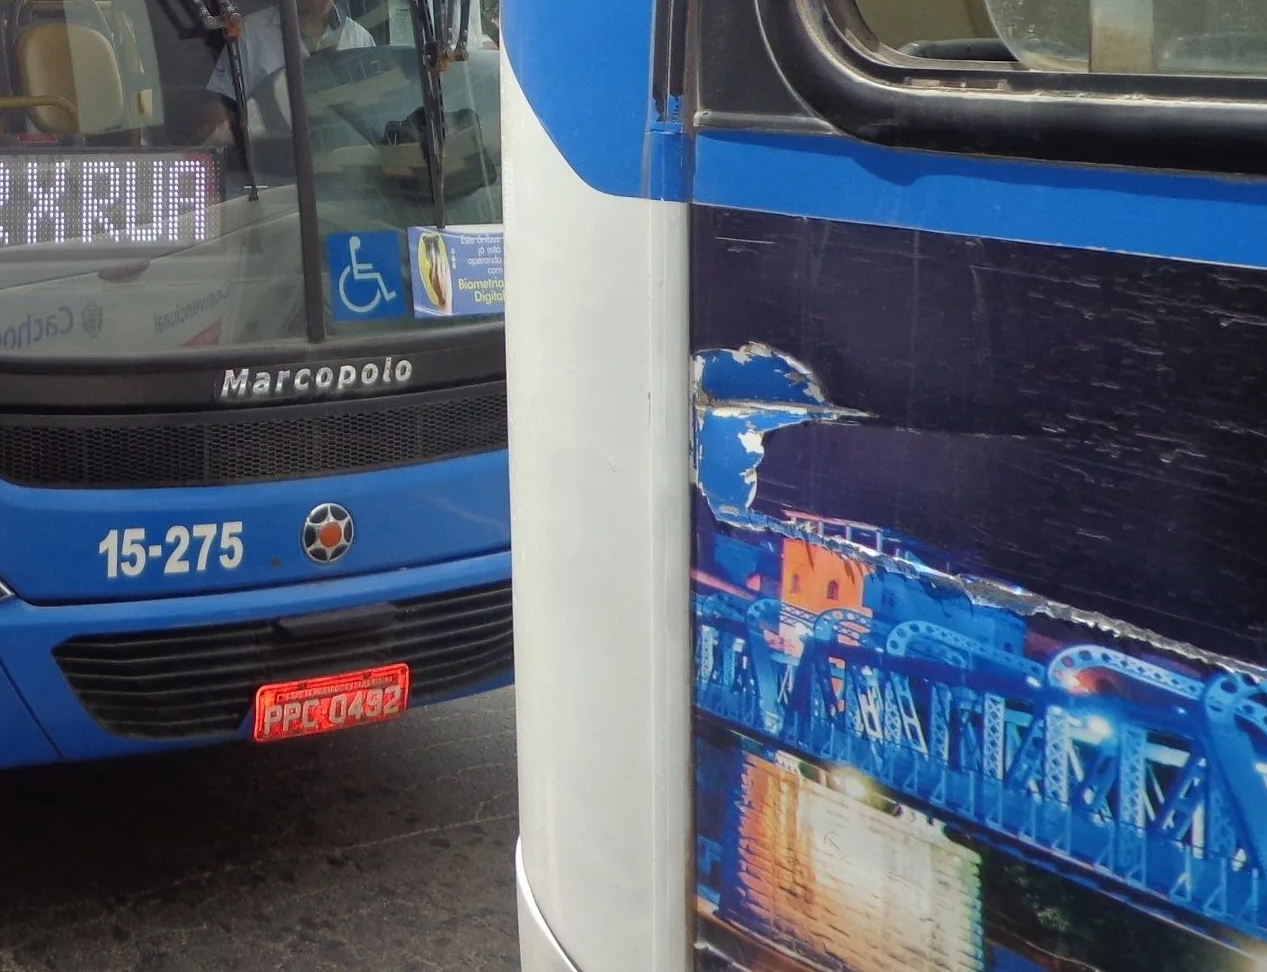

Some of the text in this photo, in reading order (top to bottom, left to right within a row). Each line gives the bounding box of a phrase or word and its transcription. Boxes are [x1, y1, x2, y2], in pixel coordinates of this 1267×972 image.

[26, 161, 66, 245] X
[82, 160, 207, 243] RUA
[220, 356, 413, 401] Marcopolo
[98, 520, 245, 579] 15-275
[263, 698, 320, 736] PPC
